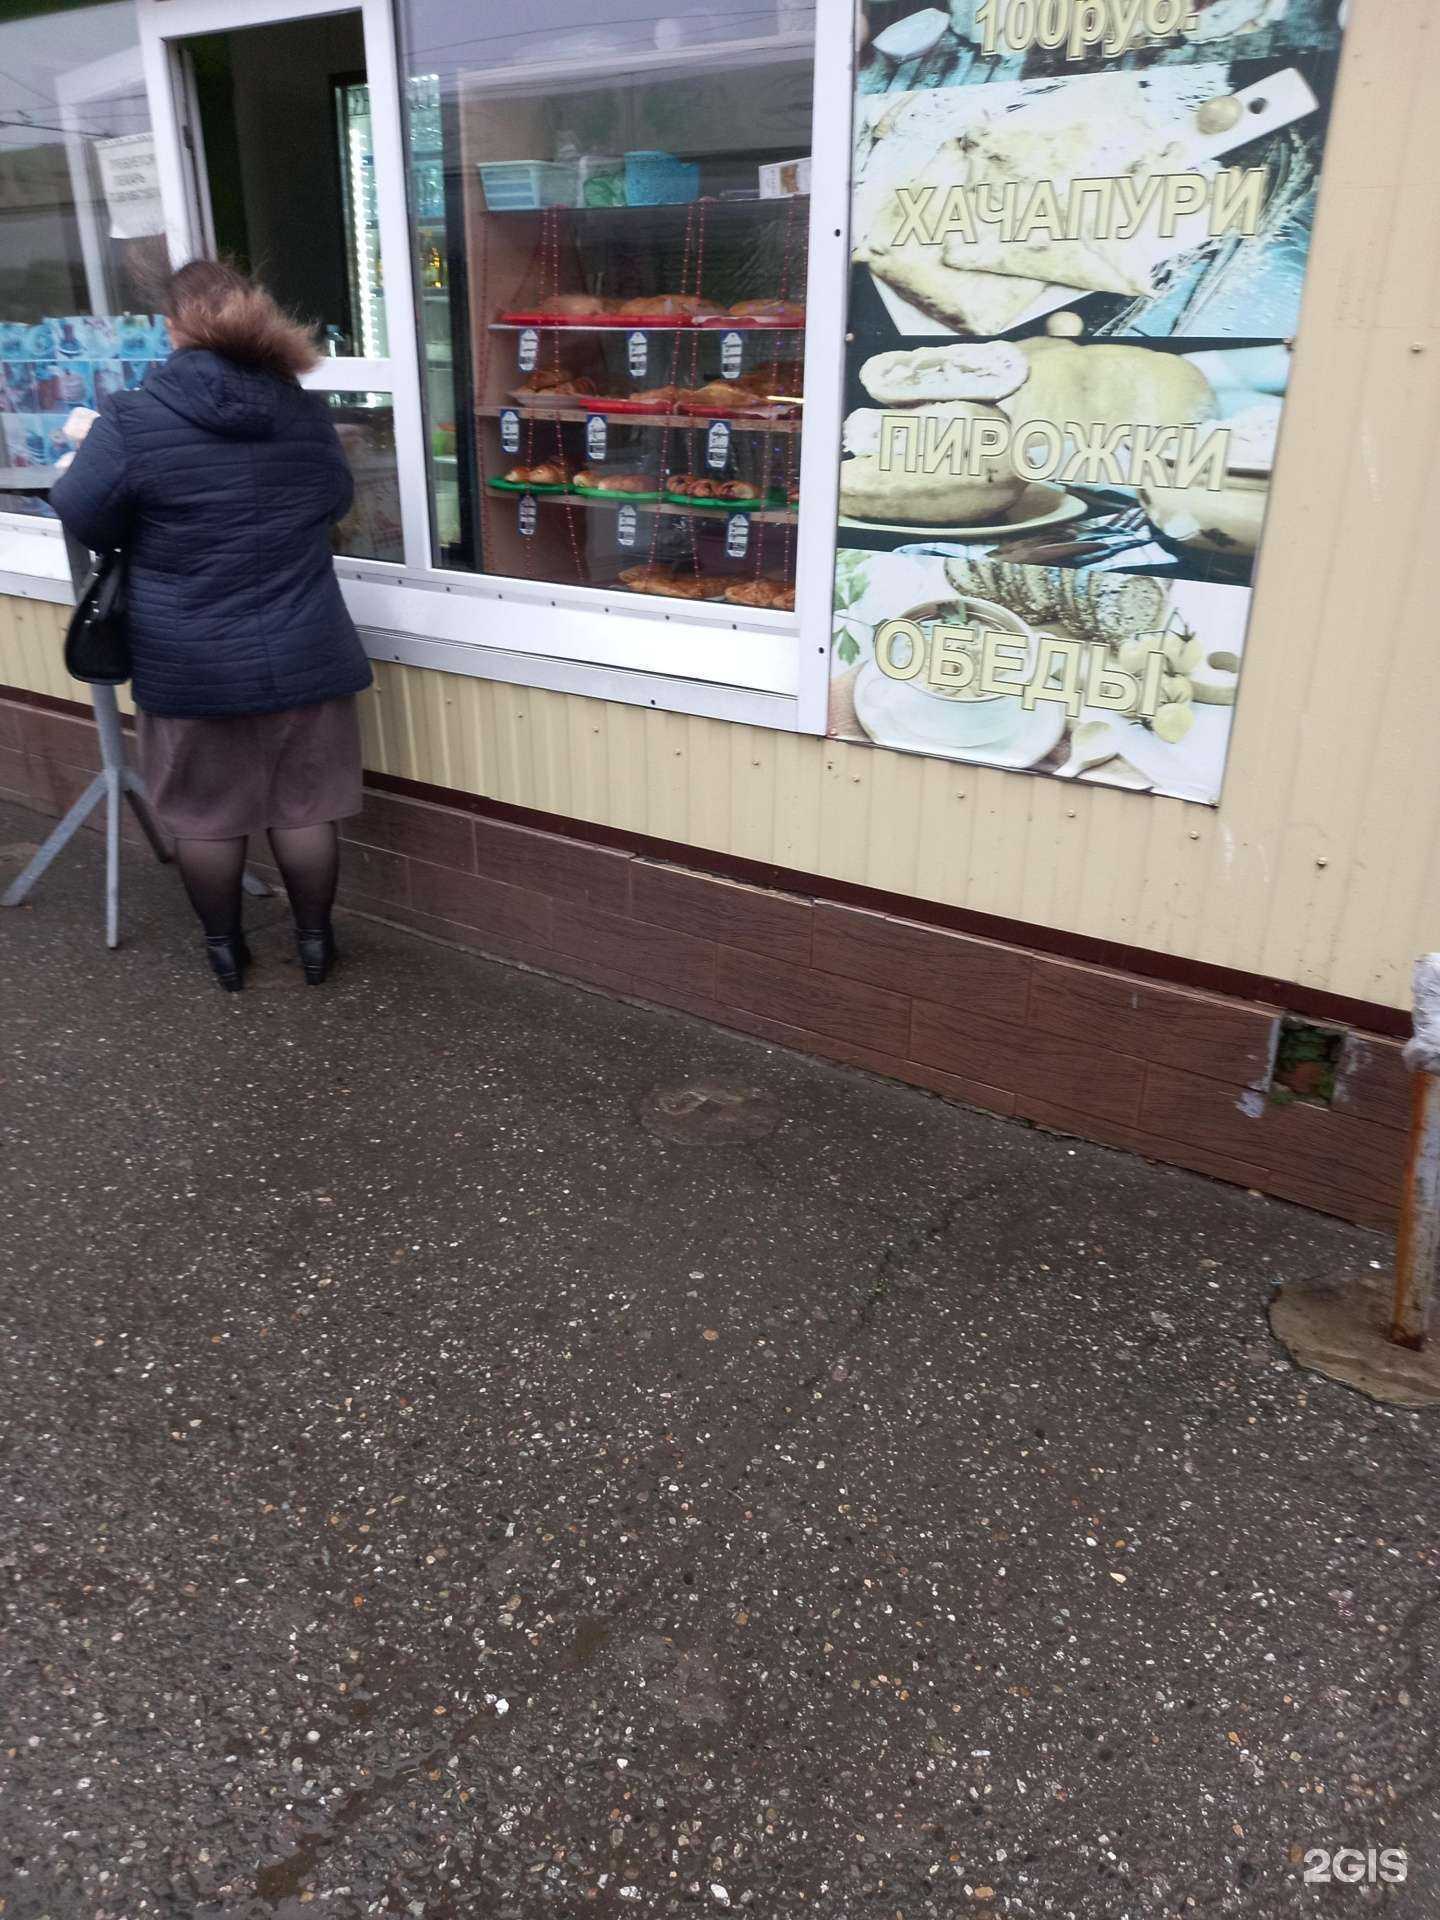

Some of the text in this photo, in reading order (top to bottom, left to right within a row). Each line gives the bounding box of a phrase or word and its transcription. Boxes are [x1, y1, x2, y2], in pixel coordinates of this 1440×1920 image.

[975, 0, 1200, 61] 100руб.
[891, 165, 1271, 247] ХАЧАПУРИ
[878, 414, 1231, 492] ПИРОЖКИ
[873, 617, 1168, 719] ОБЕДЫ
